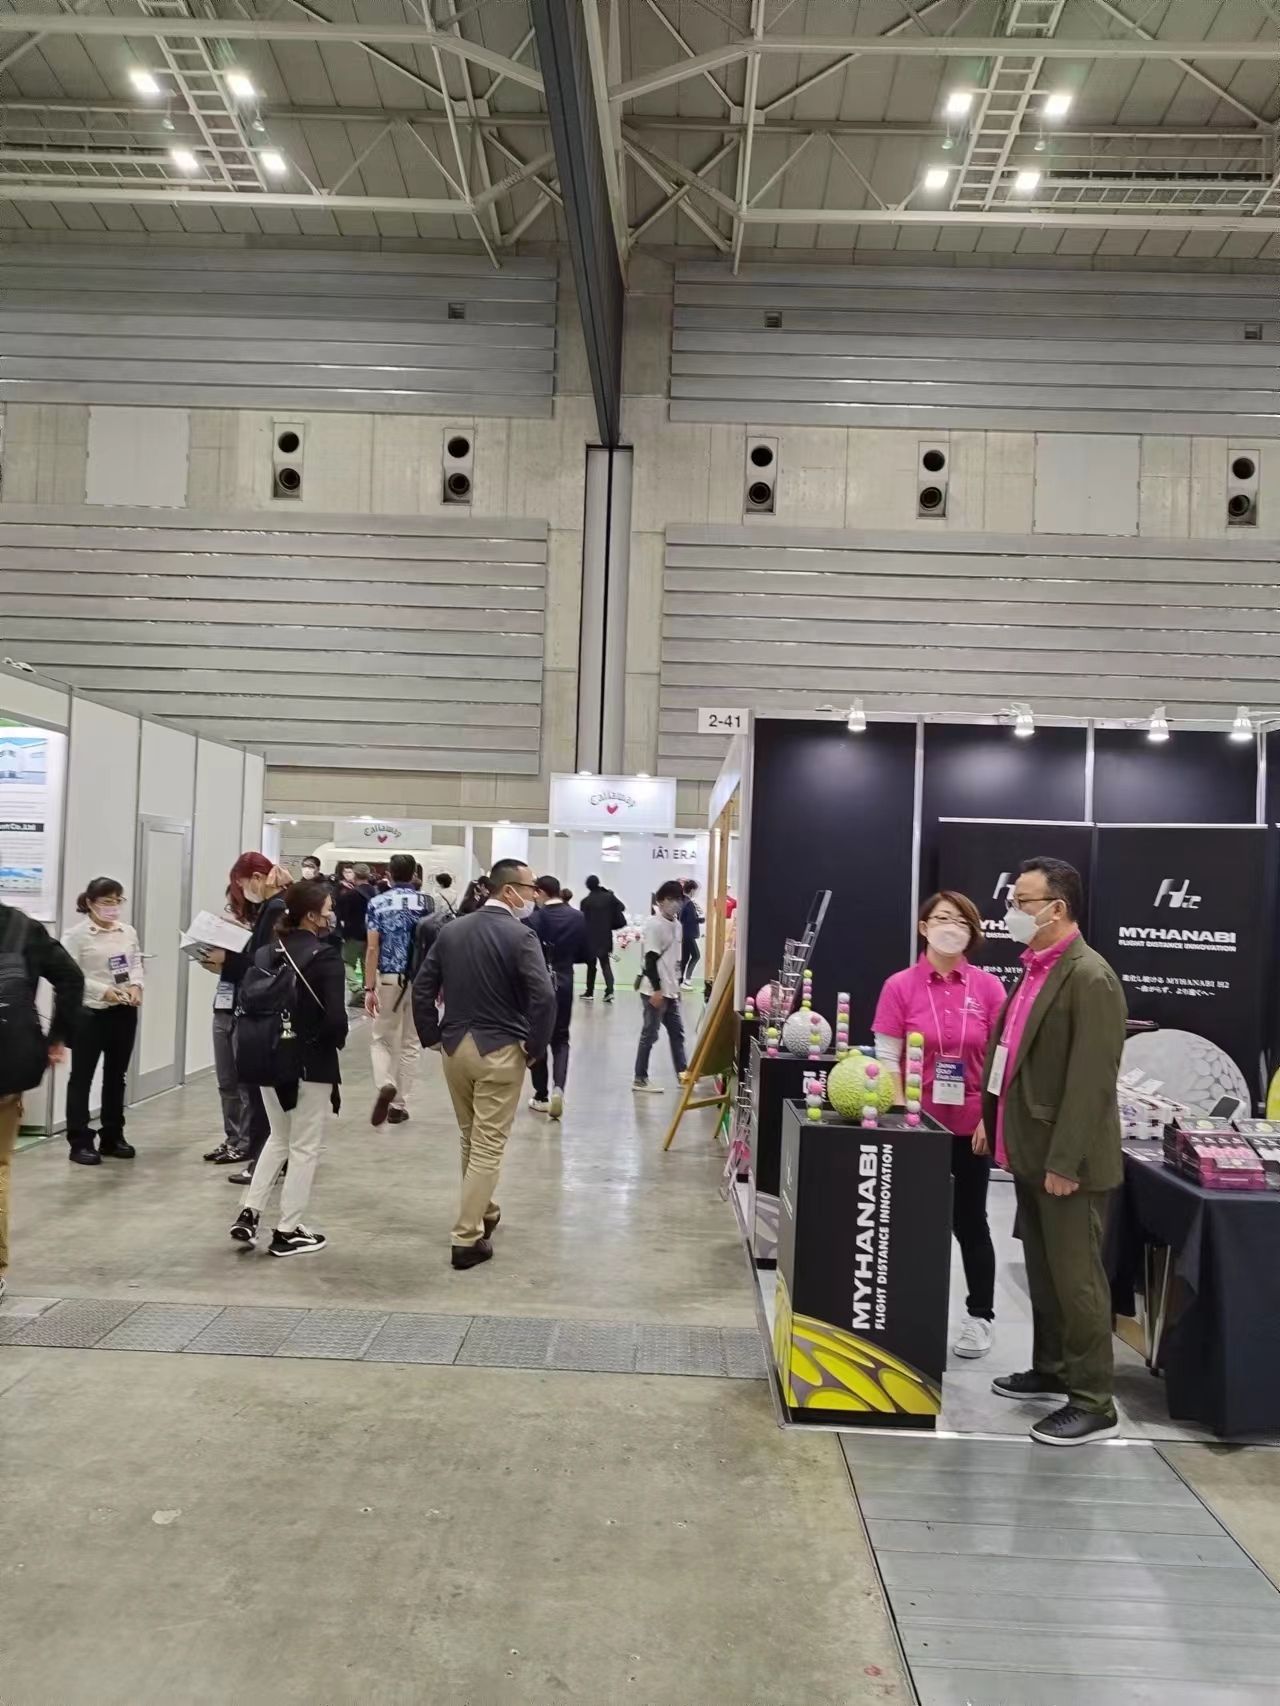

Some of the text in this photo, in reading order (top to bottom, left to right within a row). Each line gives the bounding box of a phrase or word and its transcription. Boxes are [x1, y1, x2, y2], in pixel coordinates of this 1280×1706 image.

[709, 714, 740, 728] 2-41
[1118, 926, 1237, 943] MYHANABI
[852, 1144, 878, 1330] MYHANABI
[874, 1143, 893, 1330] FLIGHT DISTANCE INNOVATION
